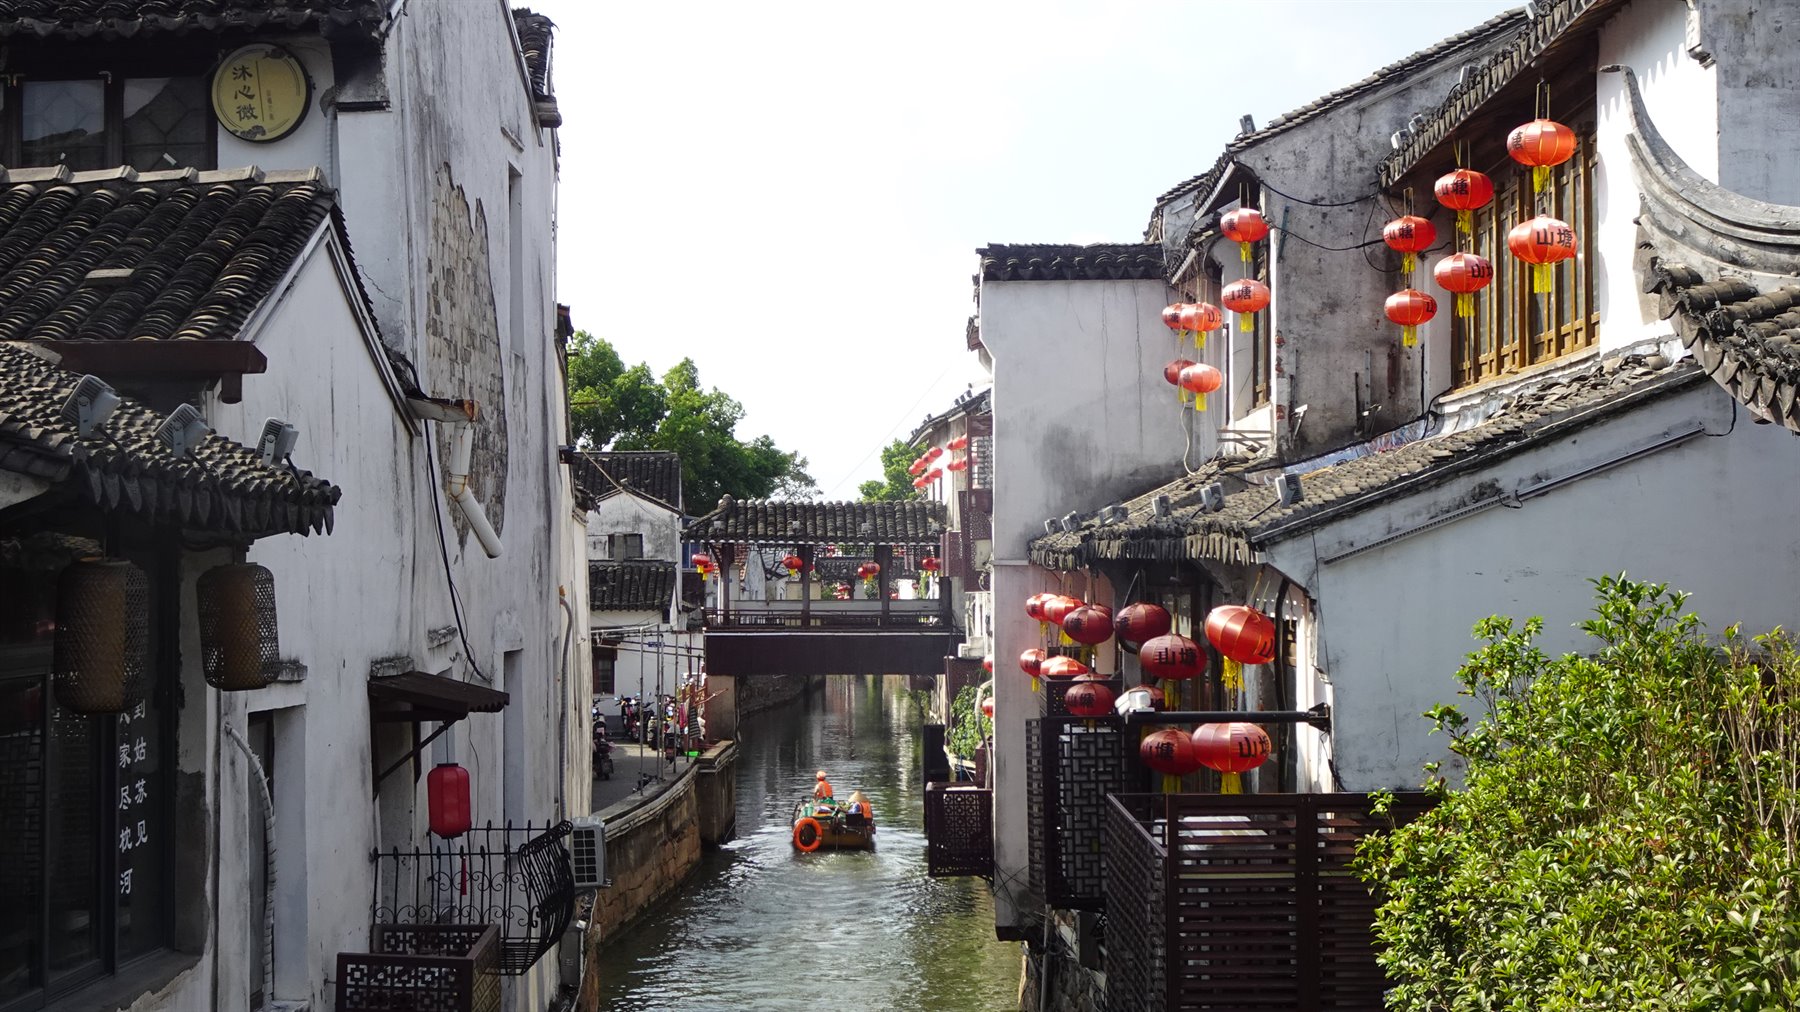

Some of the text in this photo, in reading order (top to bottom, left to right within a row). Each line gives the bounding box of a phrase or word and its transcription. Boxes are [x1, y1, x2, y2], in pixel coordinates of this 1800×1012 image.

[232, 65, 258, 122] 沐心微
[1536, 228, 1573, 249] 山塘
[1157, 647, 1198, 666] 山塘
